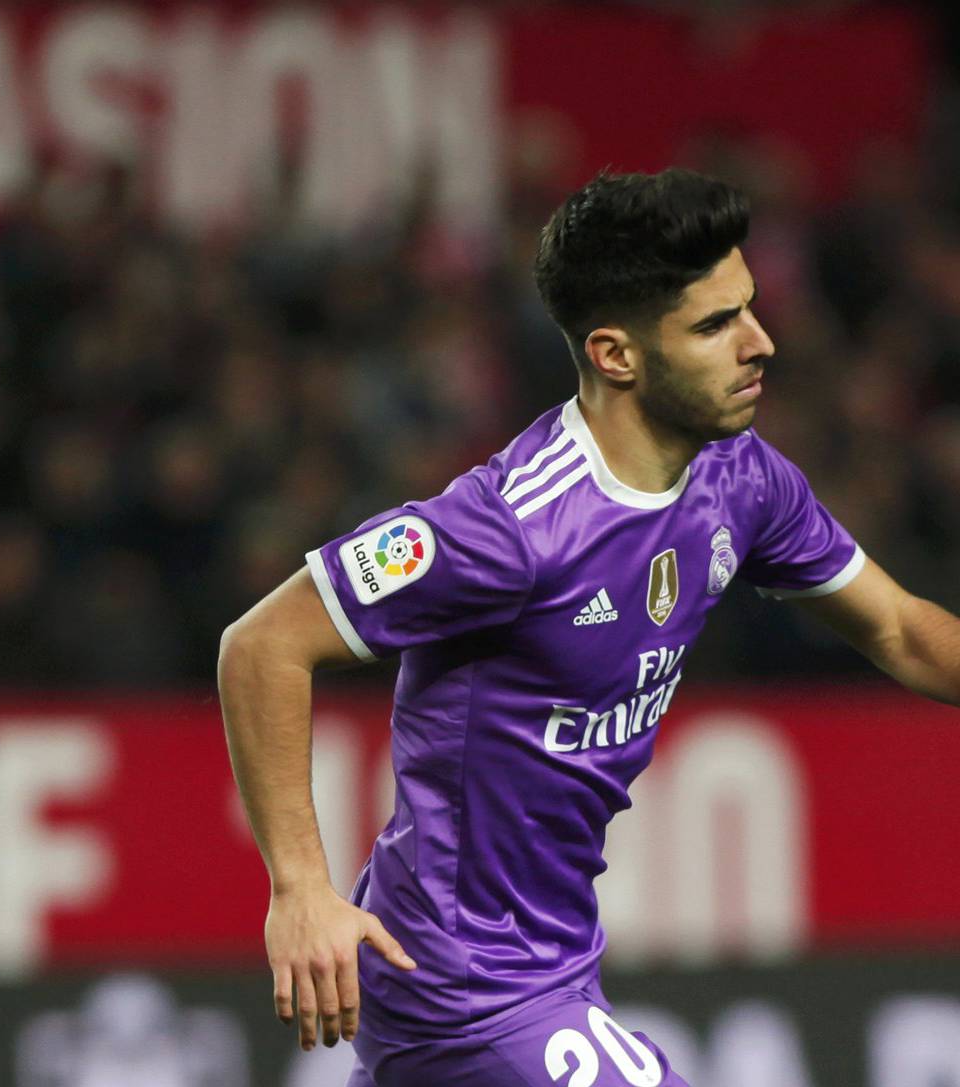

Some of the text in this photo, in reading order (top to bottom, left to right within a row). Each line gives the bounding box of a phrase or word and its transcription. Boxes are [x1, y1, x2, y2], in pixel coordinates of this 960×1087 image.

[353, 542, 381, 594] LaLiga
[573, 609, 619, 626] adidas
[636, 644, 686, 690] Fly
[543, 668, 682, 753] Emirat
